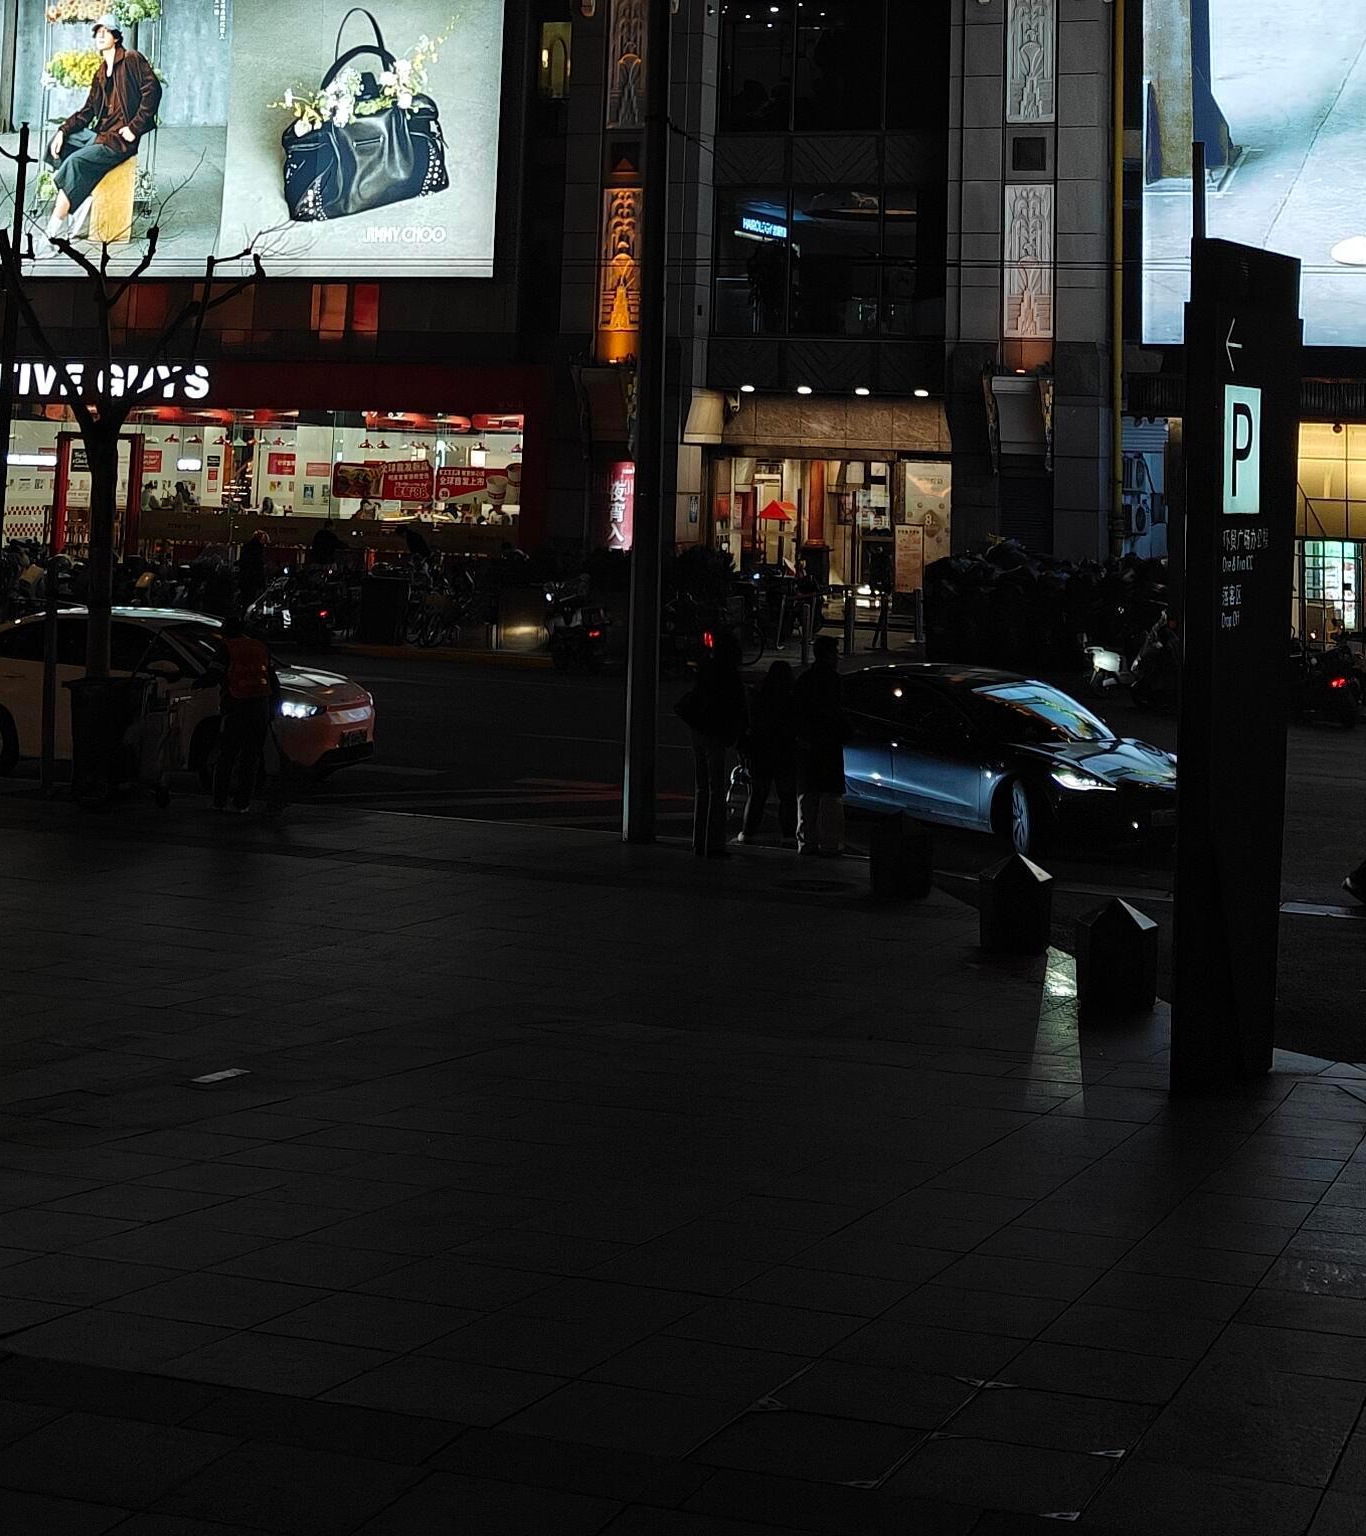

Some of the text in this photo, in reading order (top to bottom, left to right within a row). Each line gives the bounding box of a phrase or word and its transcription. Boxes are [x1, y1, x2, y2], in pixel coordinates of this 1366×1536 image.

[362, 226, 447, 244] JIMMY CHOO
[1231, 403, 1253, 497] P
